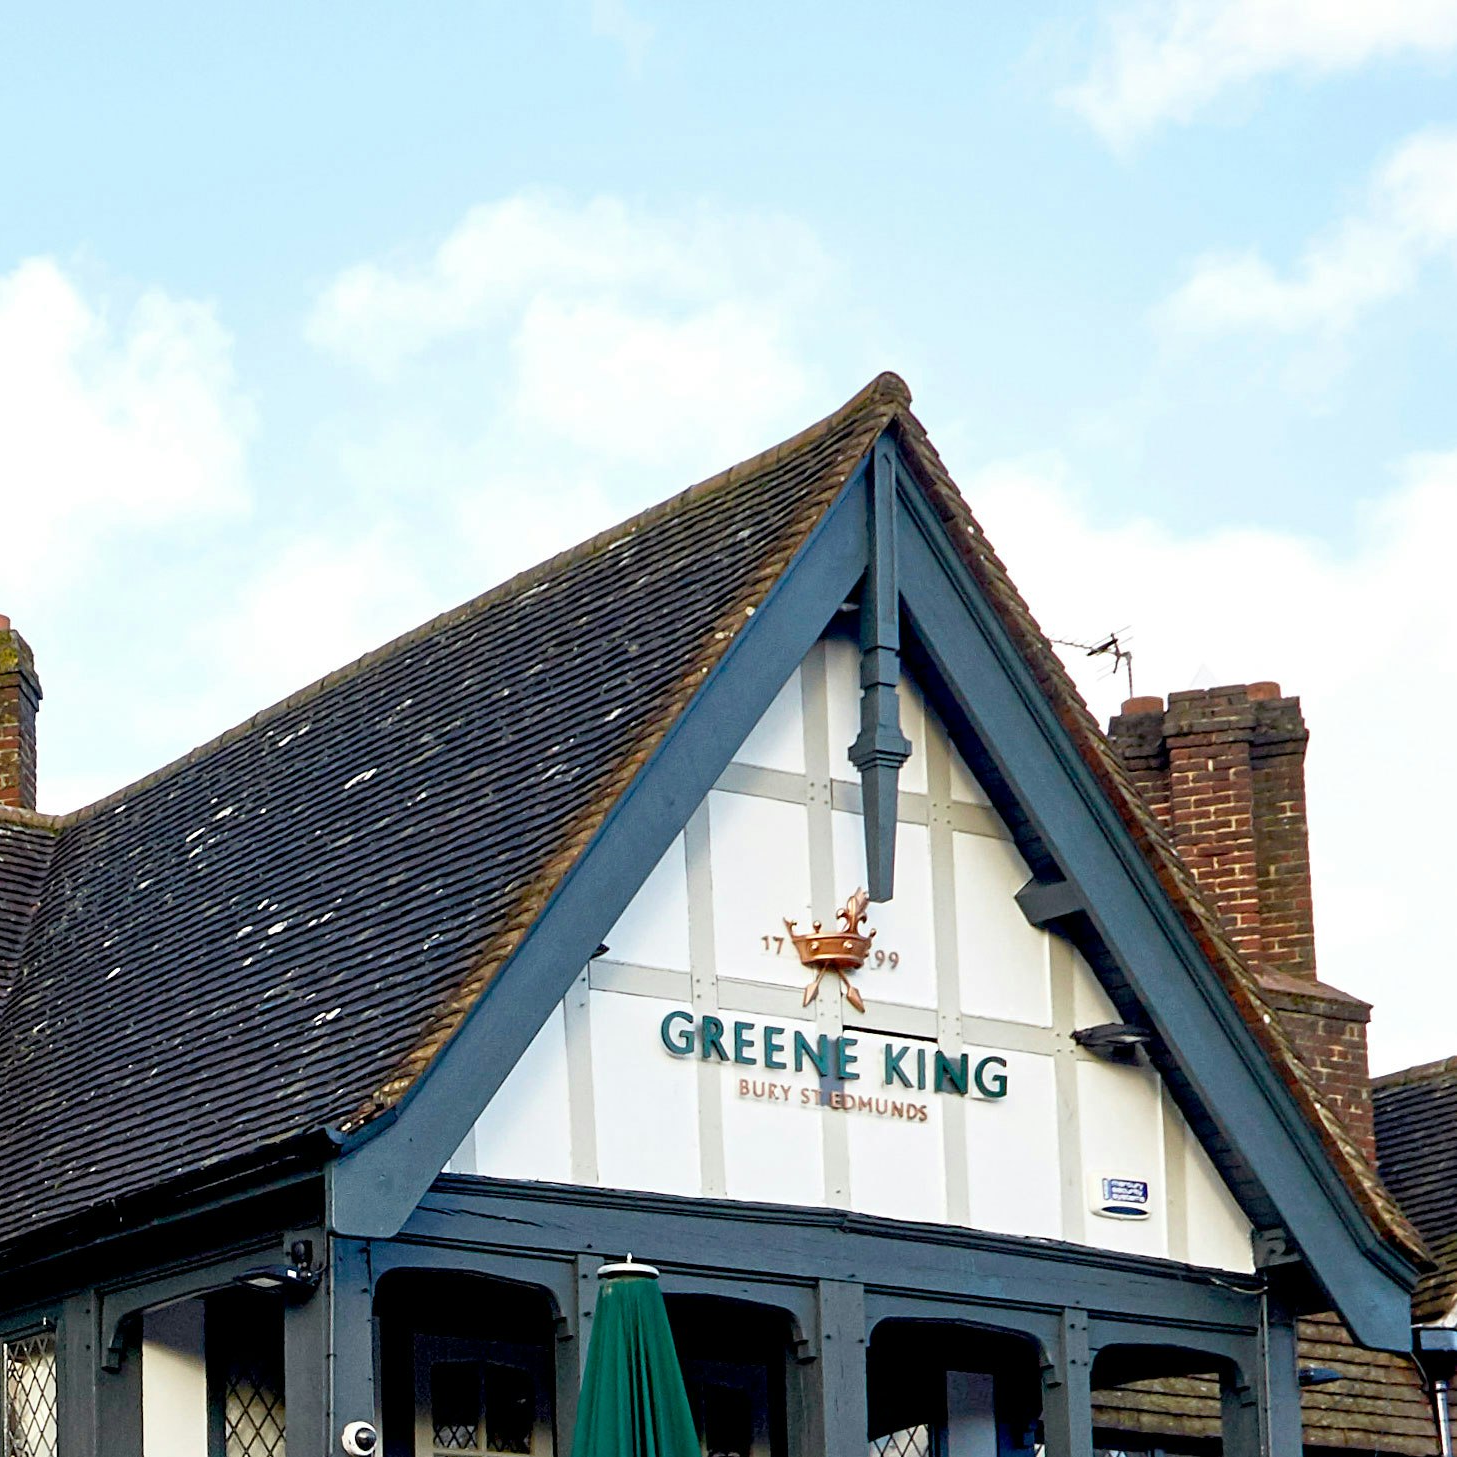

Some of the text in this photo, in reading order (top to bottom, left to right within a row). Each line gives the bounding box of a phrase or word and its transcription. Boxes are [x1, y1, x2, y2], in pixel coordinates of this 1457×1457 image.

[761, 935, 900, 970] 17 99
[661, 1010, 1008, 1099] GREENE KING
[739, 1078, 928, 1122] BURY ST EDMUNDS
